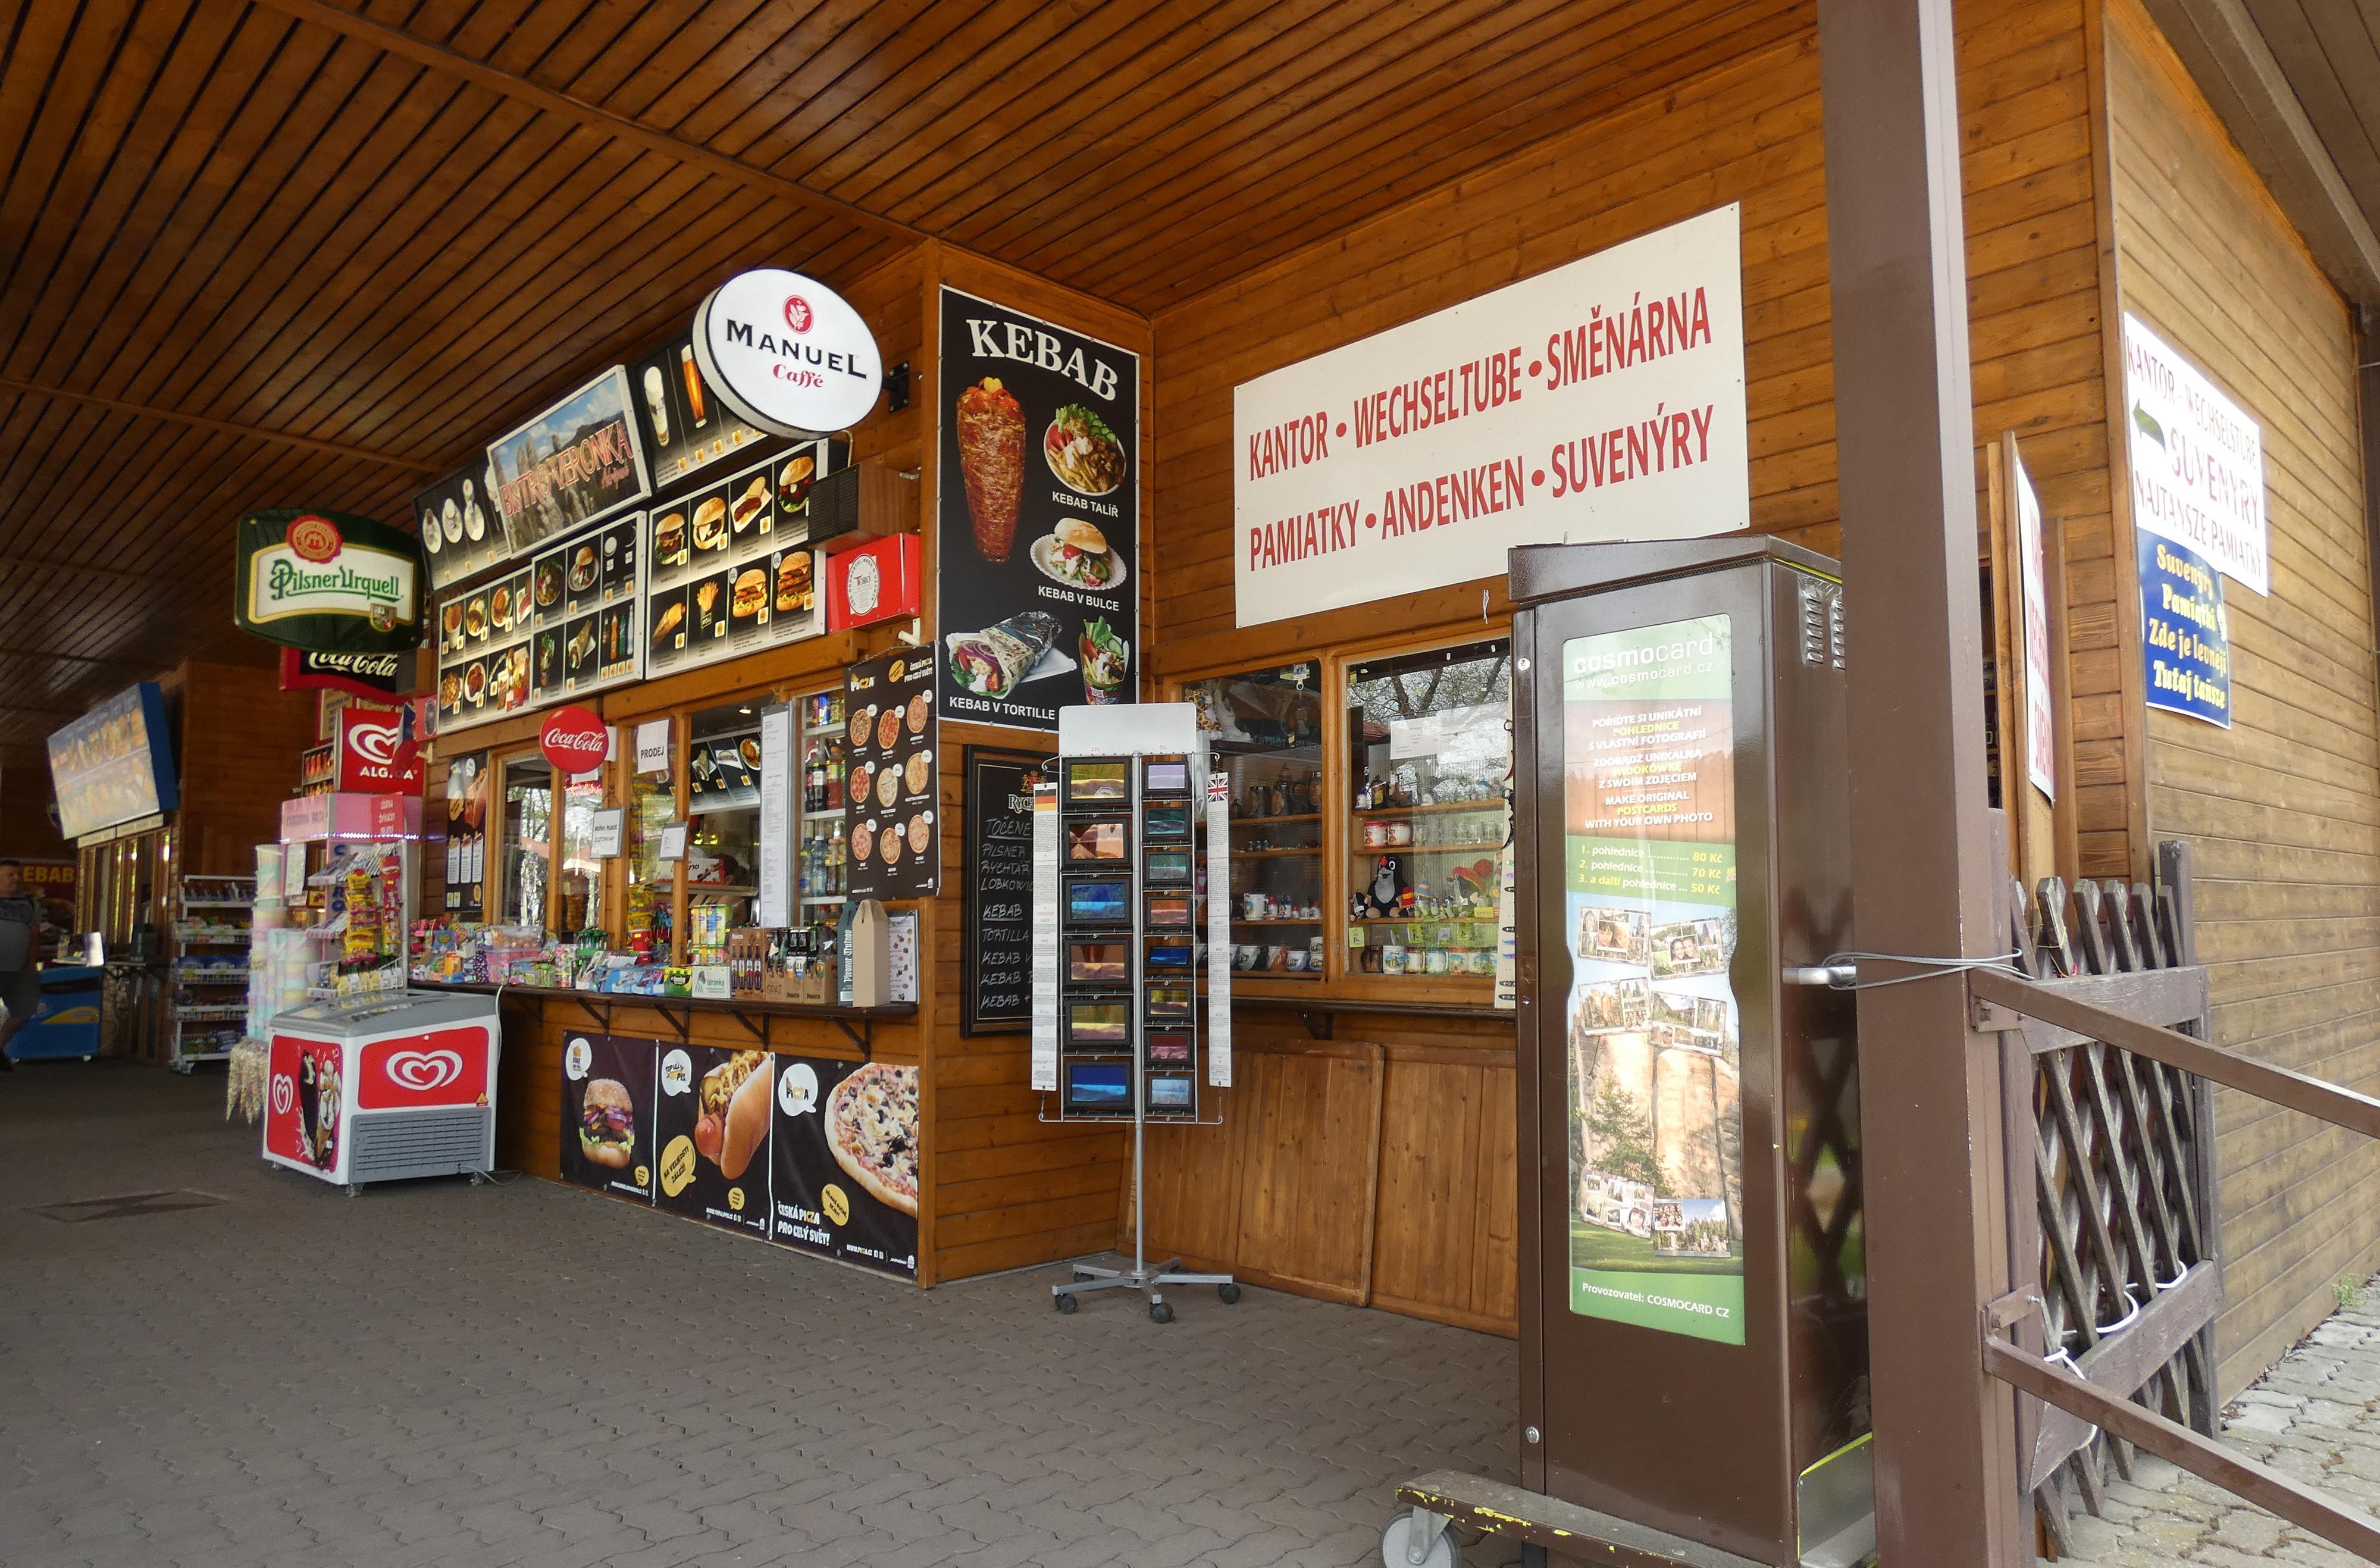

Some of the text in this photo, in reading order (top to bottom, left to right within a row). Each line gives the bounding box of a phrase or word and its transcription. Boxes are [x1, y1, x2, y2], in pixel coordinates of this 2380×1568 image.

[726, 318, 867, 380] MANUEL
[966, 320, 1118, 401] KEBAB
[773, 364, 823, 388] Caffé
[2127, 336, 2175, 405] KANTOR
[1250, 286, 1712, 481] KANTOR WECHSELTUBE SMĚNÁRNA
[499, 465, 552, 517] BISTRO
[547, 420, 634, 491] VERONIKA
[1250, 402, 1714, 572] PAMIATKY ANDENKEN SUVENÝRY
[1052, 492, 1119, 518] KEBAB TALÍŘ
[270, 559, 399, 600] Pilsner Urquell
[2156, 543, 2214, 601] Suvenýry
[1038, 586, 1119, 612] KEBAB V BULCE
[2149, 617, 2177, 651] Zde
[2178, 628, 2191, 659] je
[1574, 631, 1714, 674] cosmocard
[309, 652, 398, 677] CocaCola
[1574, 661, 1714, 691] www.cosmocard.cz
[2153, 659, 2193, 702] Tutaj
[949, 696, 1056, 720] KEBAB V TORTILLE
[1637, 713, 1648, 723] SI
[1648, 705, 1702, 722] UNIKÁTNÍ
[544, 727, 604, 753] Coca-Cola
[1589, 728, 1706, 751] S VLASTNÍ FOTOGRAFIÍ
[1613, 721, 1680, 737] POHLEDNICE
[640, 746, 665, 759] PRODEJ
[360, 766, 415, 780] ALGA
[1598, 780, 1606, 789] Z
[1607, 777, 1643, 788] SWOIM
[1008, 794, 1034, 813] RYCH
[1605, 791, 1690, 806] MAKE ORIGINAL
[1617, 803, 1678, 815] POSTCARDS
[1585, 812, 1714, 829] WITH YOUR OWN PHOTO
[982, 843, 1025, 857] PILSNER
[1581, 845, 1723, 863] 1. pohlednice 80 Kč
[24, 866, 73, 882] EBAB
[1580, 859, 1722, 879] 2. pohlednice 70 Kč
[981, 878, 1034, 891] LOBKOWIC
[1579, 874, 1587, 884] 3.
[1598, 875, 1621, 887] další
[1623, 877, 1677, 891] pohlednice
[1691, 882, 1705, 893] 50
[1707, 882, 1721, 894] Kč
[983, 903, 1022, 918] KEBAB
[982, 928, 1029, 943] TORTILLA
[982, 951, 1021, 965] KEBAB
[980, 971, 1022, 987] KEBAB
[980, 994, 1019, 1009] KEBAB
[663, 1146, 689, 1180] NA VELIKOSTI
[778, 1200, 798, 1220] ČESKÁ
[777, 1220, 793, 1235] PRO
[793, 1225, 809, 1241] CELÝ
[809, 1228, 831, 1247] SVĚT!
[1582, 1282, 1730, 1319] Provozovatel: COSMOCARD CZ
